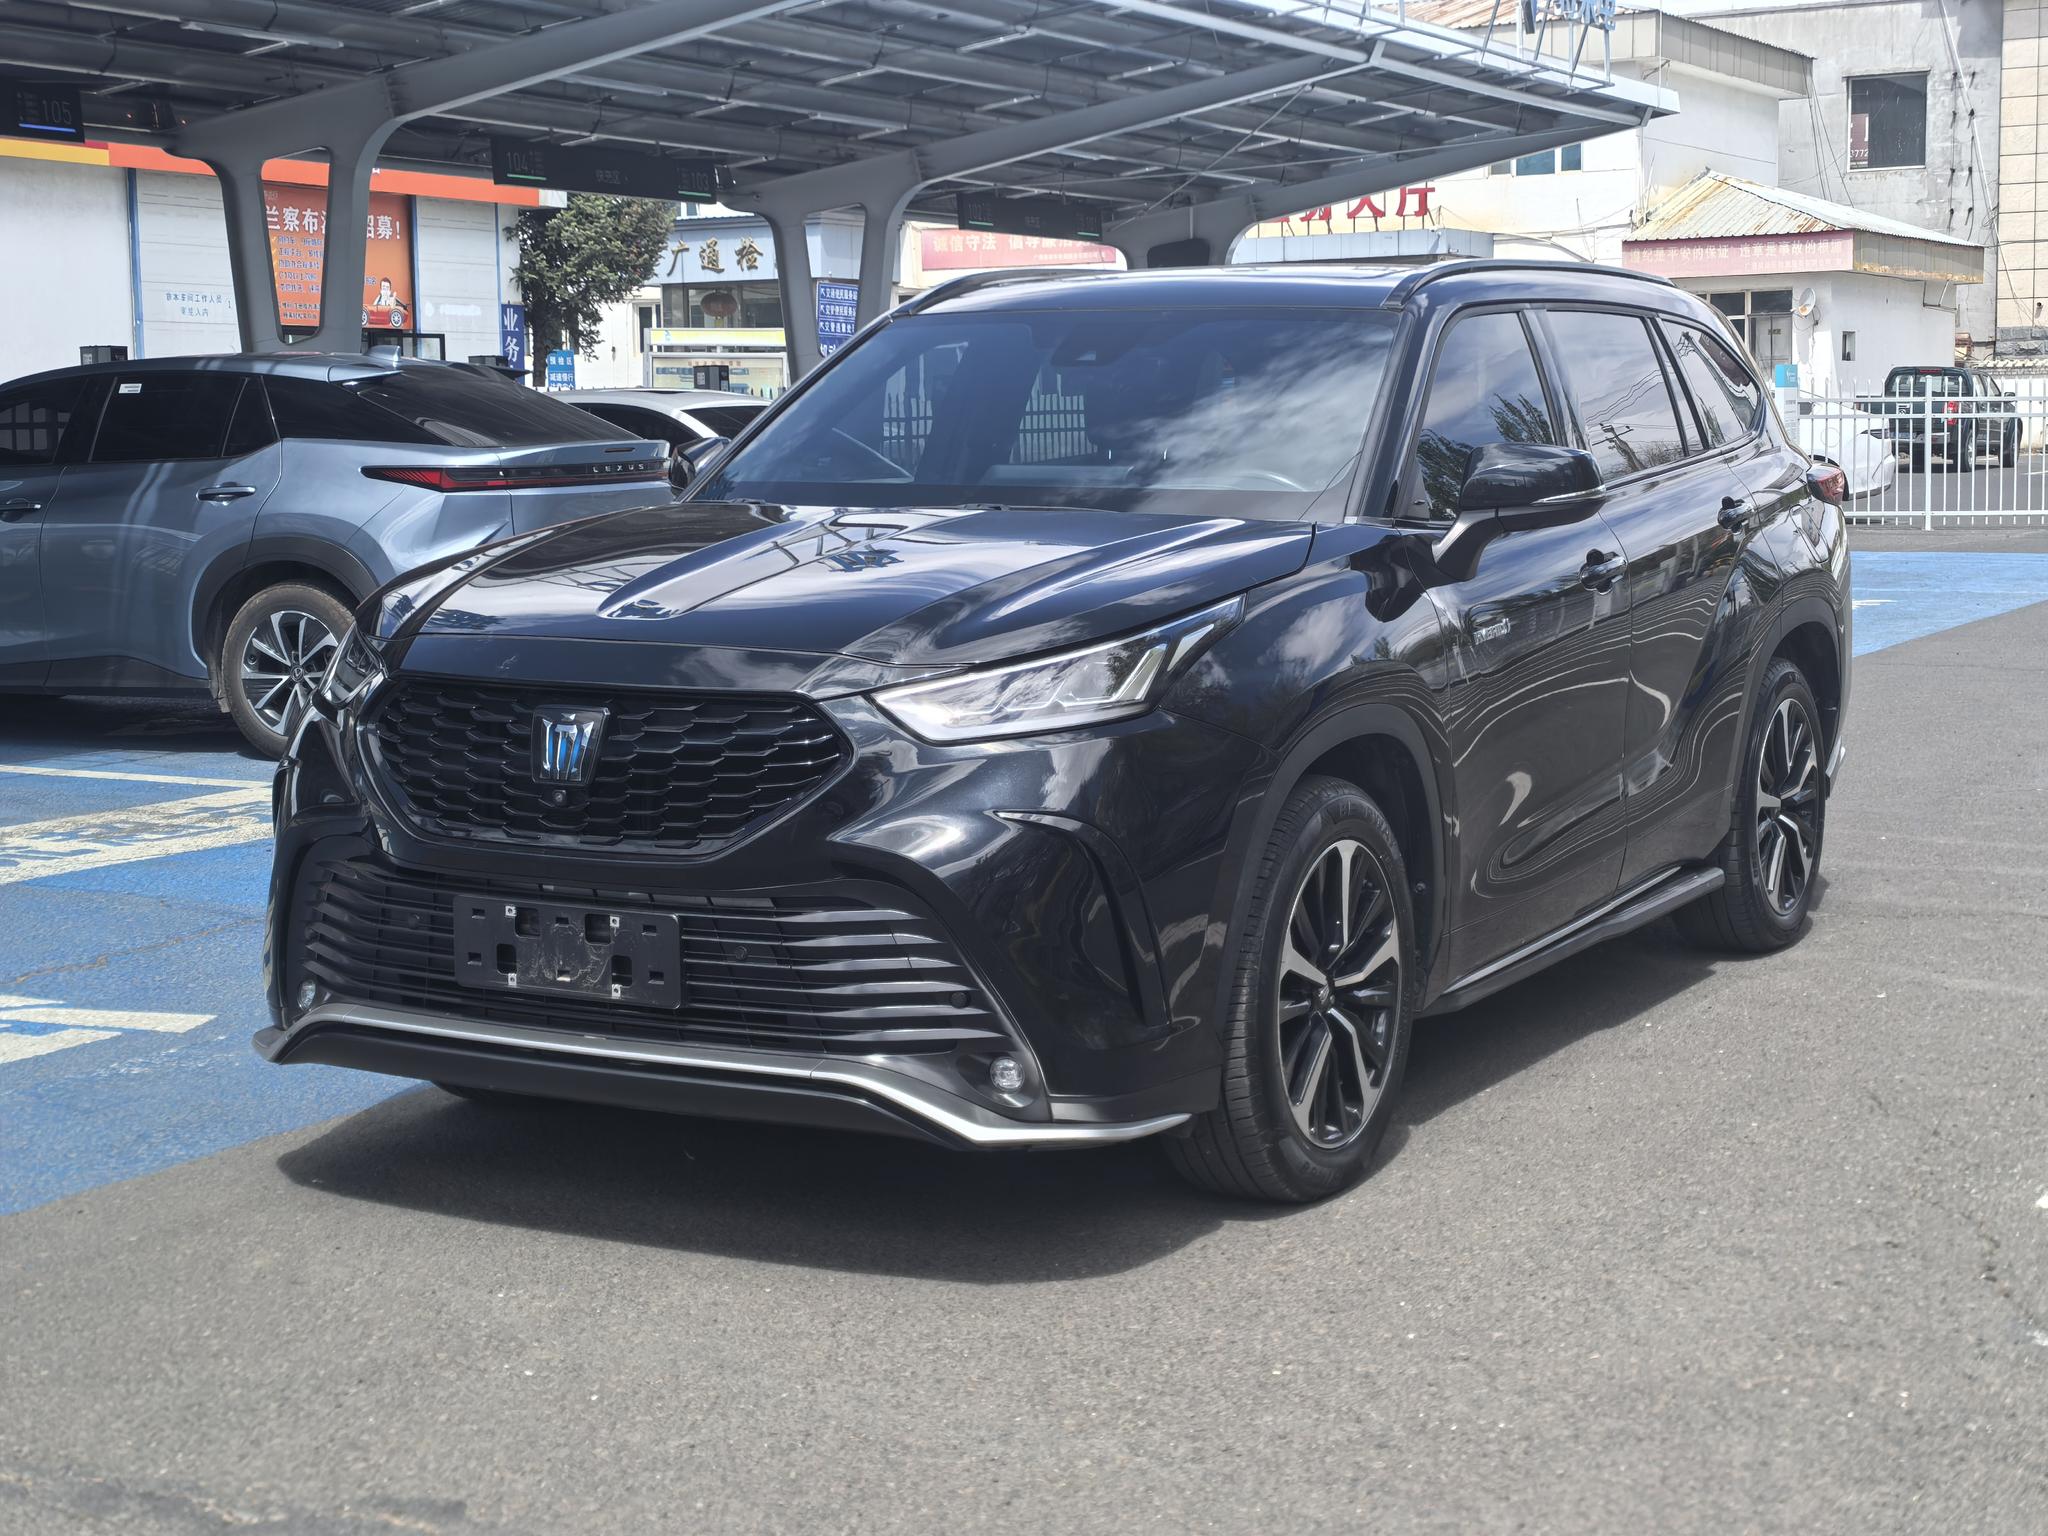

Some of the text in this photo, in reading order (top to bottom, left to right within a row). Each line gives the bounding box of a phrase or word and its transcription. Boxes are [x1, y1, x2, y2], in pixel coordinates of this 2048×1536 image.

[42, 99, 73, 125] 105
[506, 151, 529, 173] 104
[265, 205, 327, 234] 兰察布
[592, 463, 645, 473] LEXUS
